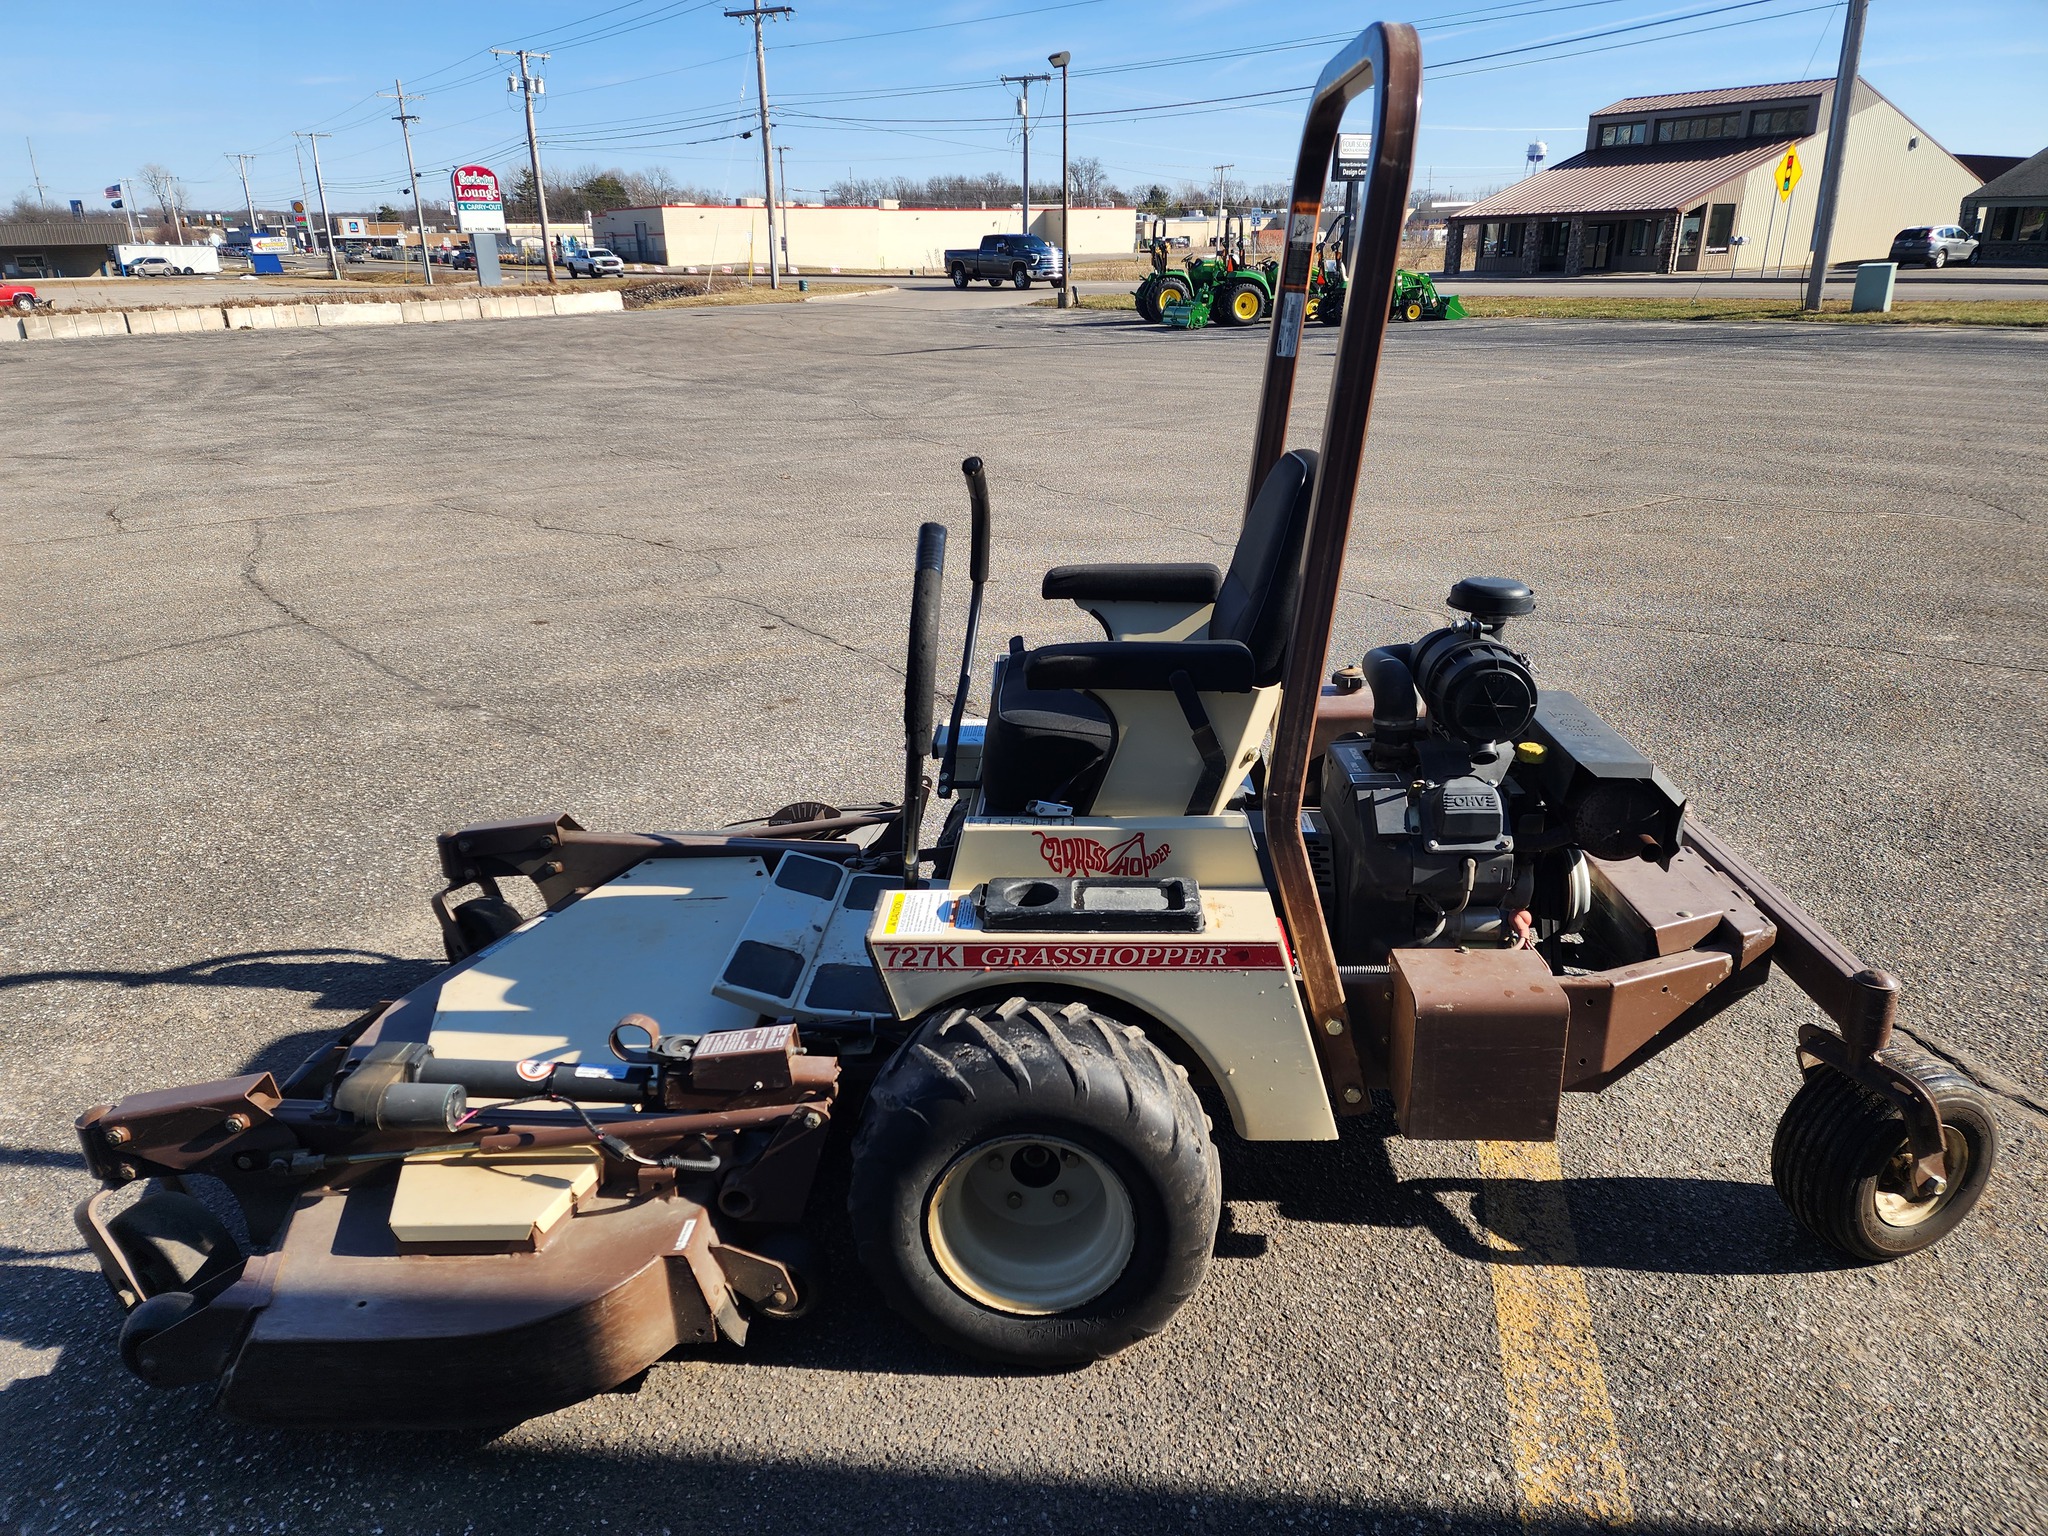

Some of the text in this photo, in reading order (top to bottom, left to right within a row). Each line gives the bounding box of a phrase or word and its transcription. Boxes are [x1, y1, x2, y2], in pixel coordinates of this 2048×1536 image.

[1342, 169, 1358, 177] Design
[457, 185, 499, 201] Lounge
[1252, 217, 1261, 225] 35
[1453, 796, 1484, 807] OHV
[1032, 831, 1171, 877] GRASSHOPPER
[884, 946, 1226, 967] 727K GRASSHOPPER
